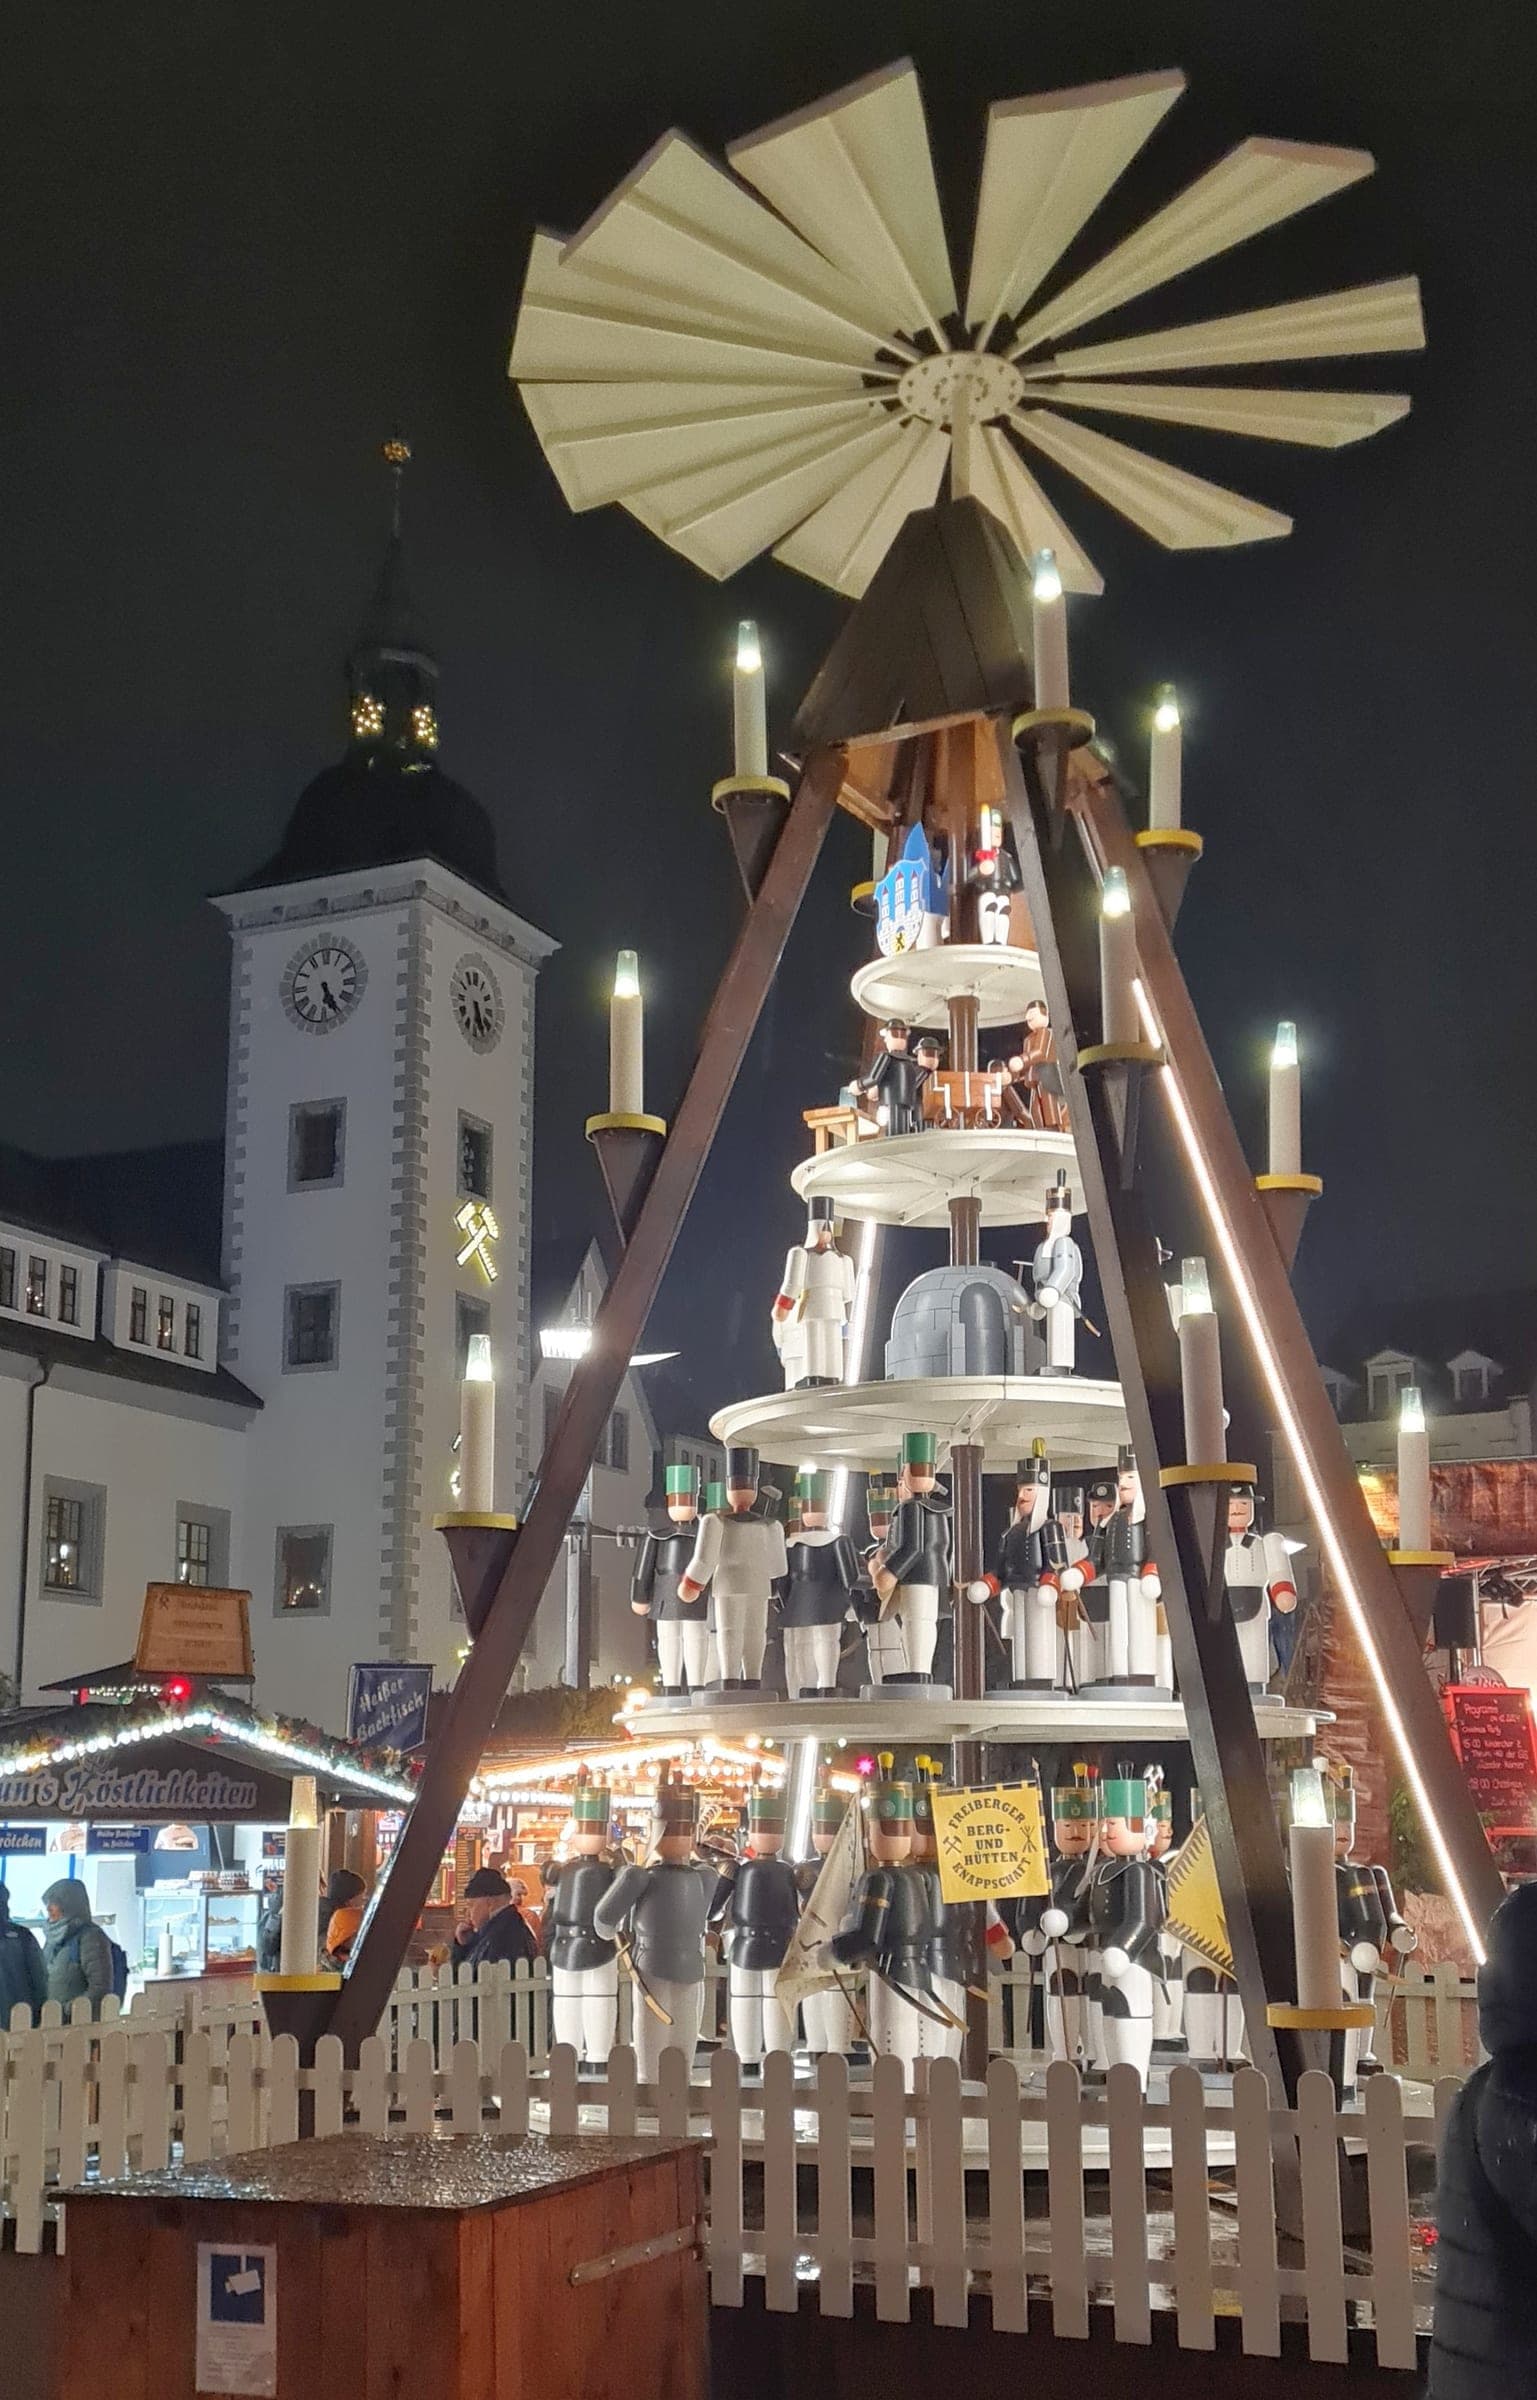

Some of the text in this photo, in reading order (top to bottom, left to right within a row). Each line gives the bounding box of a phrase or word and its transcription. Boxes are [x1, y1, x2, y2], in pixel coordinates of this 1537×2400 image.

[64, 1770, 255, 1807] Köstlichkeiten
[948, 1798, 1026, 1830] FREIBERGER
[966, 1824, 1010, 1837] BERG-
[975, 1838, 1003, 1850] UND
[964, 1851, 1018, 1866] HÜTTEN
[952, 1857, 1032, 1889] KNAPPSCHAFT
